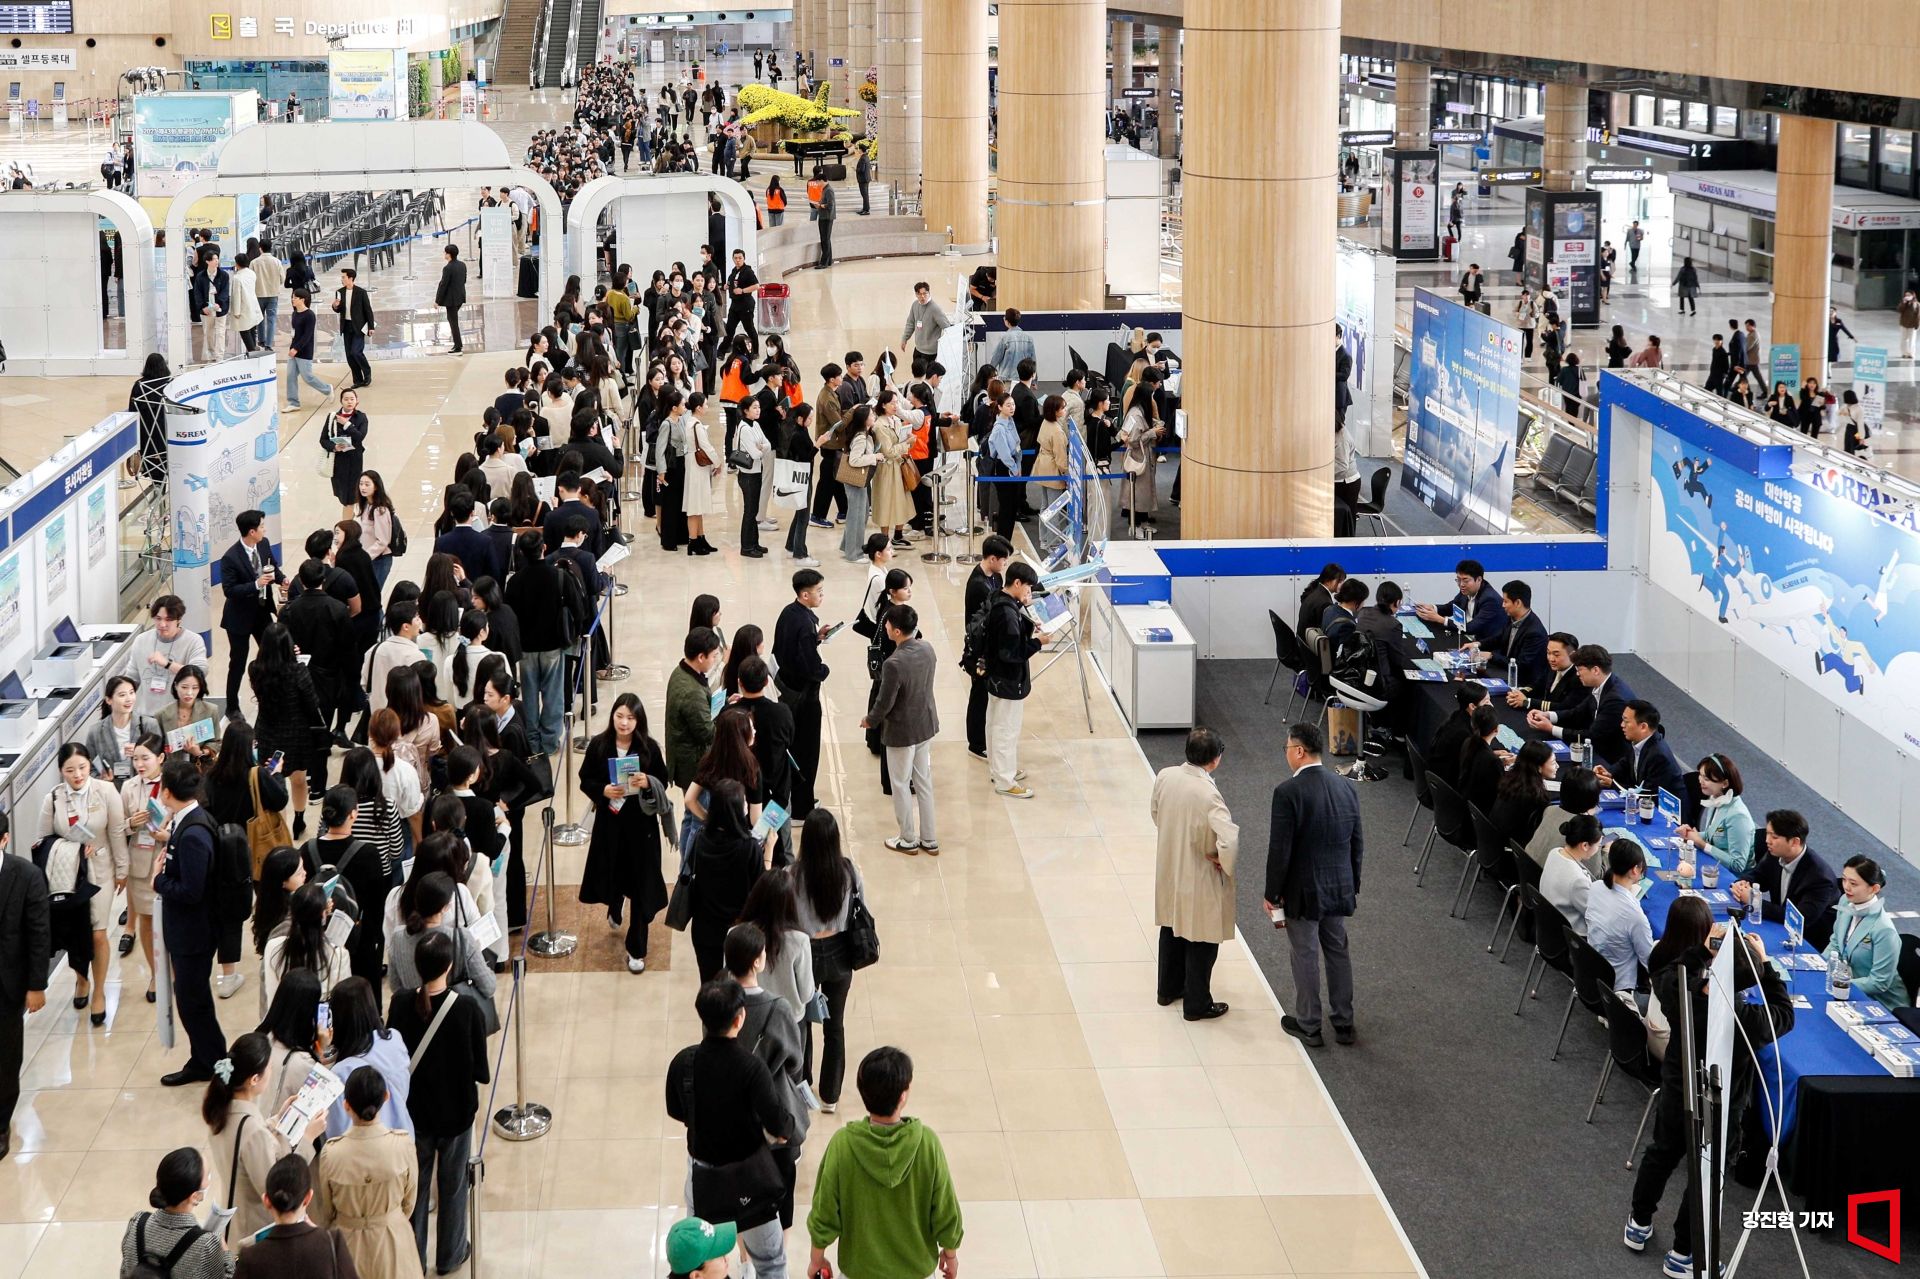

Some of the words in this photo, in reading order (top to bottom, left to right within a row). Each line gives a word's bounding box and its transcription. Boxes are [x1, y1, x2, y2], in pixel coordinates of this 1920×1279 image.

[305, 20, 389, 36] Departures
[21, 54, 70, 64] 셀프등록대
[1691, 144, 1697, 157] 2
[1702, 144, 1711, 157] 2
[213, 376, 238, 386] KOREAN
[239, 373, 252, 381] AIR
[176, 429, 207, 438] KOREA
[1764, 481, 1802, 514] 대한항공
[1735, 488, 1753, 512] 꿈의
[1755, 499, 1782, 528] 비행이
[1784, 516, 1834, 554] 시작됩니다
